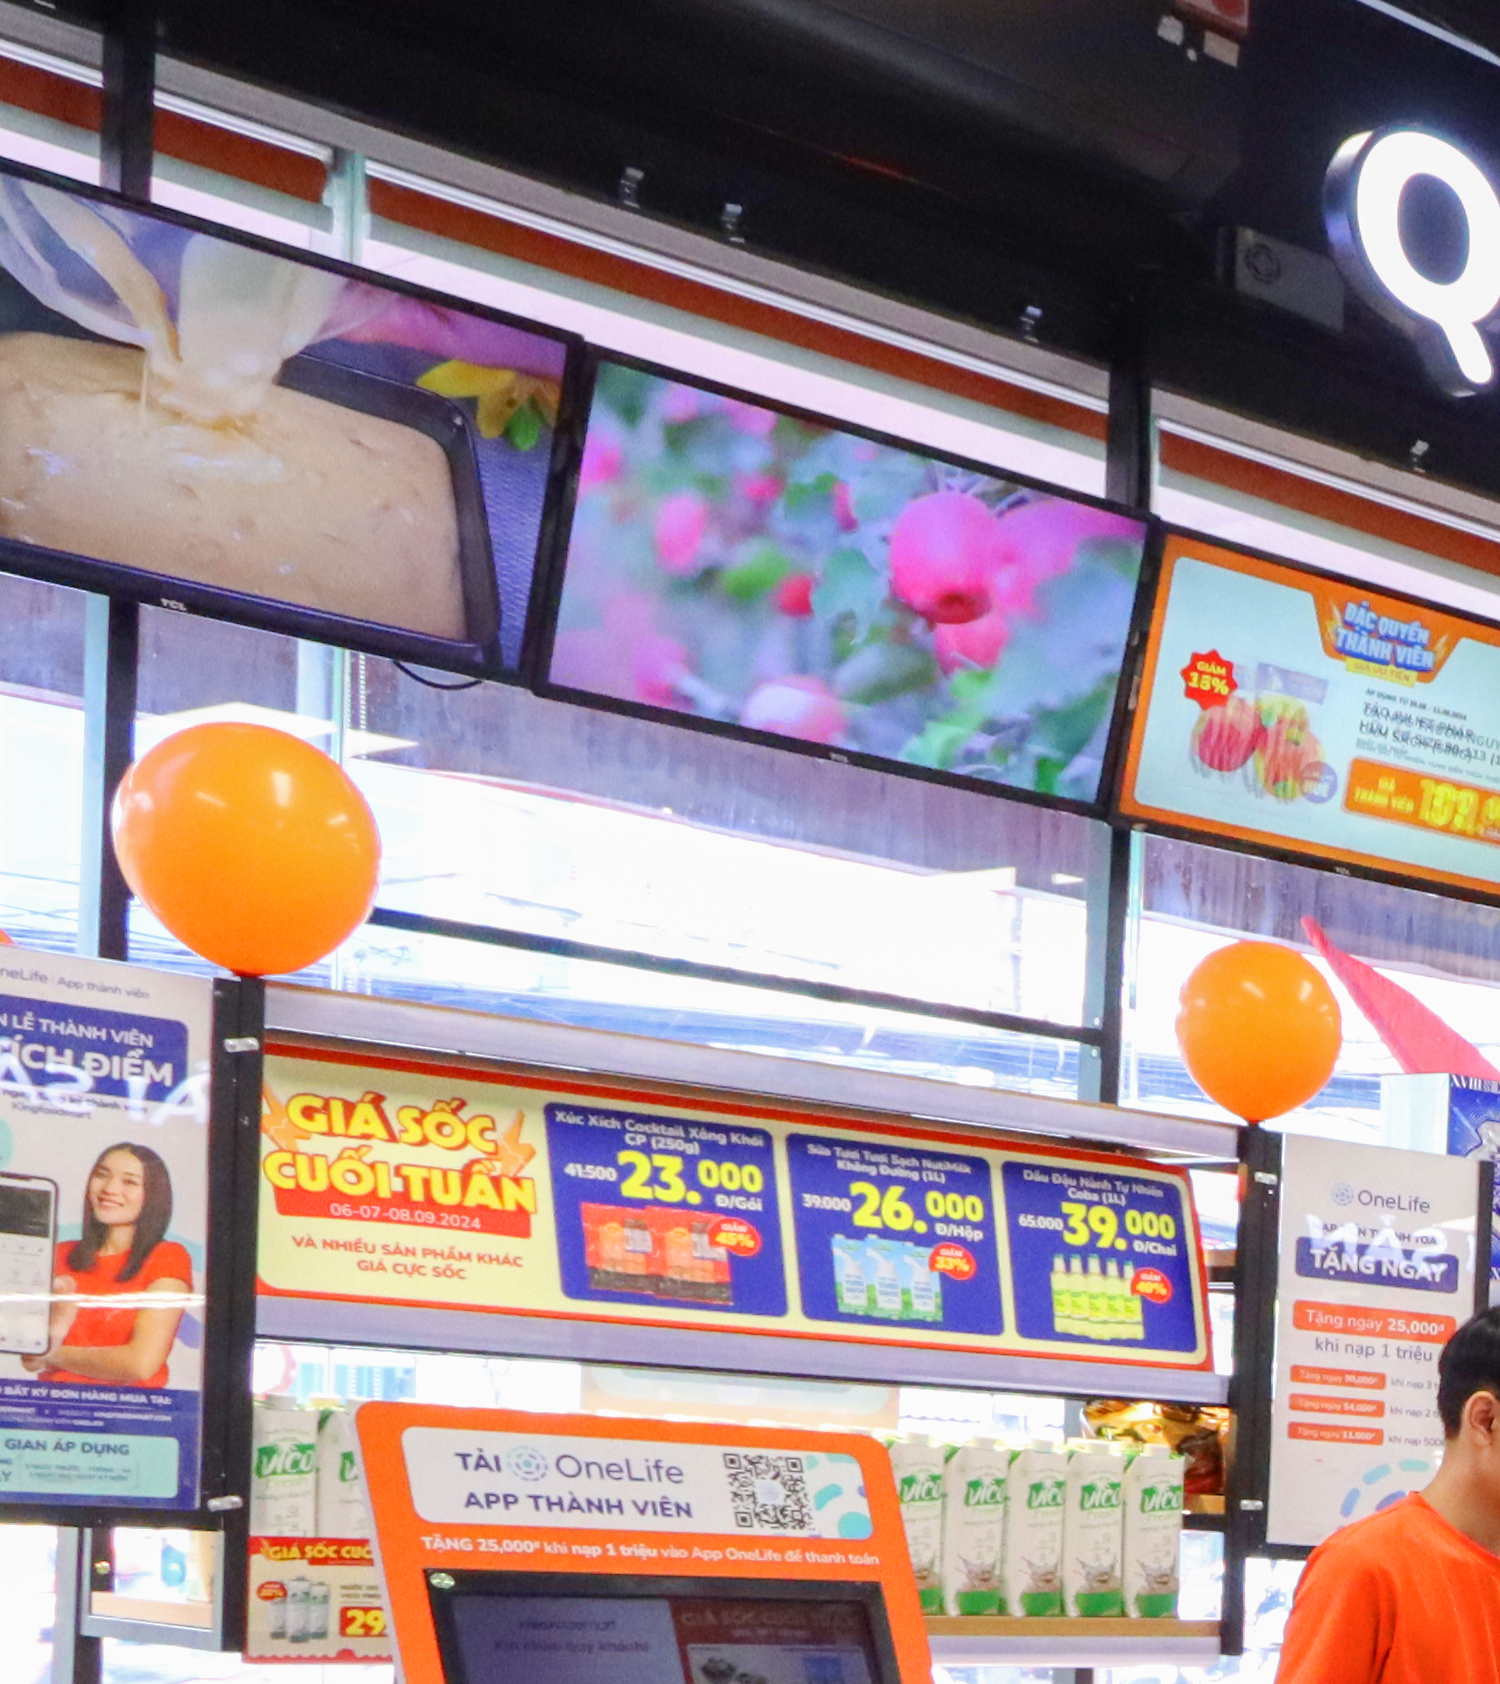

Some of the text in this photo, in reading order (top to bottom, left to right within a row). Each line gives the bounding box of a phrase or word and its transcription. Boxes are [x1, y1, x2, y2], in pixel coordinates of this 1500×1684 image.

[1343, 601, 1430, 644] ĐẶC QUYỀN
[1335, 626, 1435, 671] THÀNH VIÊN
[1188, 672, 1230, 696] 15%
[39, 1019, 154, 1048] THÀNH VIÊN
[286, 1091, 498, 1154] GIÁ SỐC
[263, 1145, 537, 1215] CUỐI TUẦN
[1357, 1189, 1432, 1215] OneLife
[292, 1234, 523, 1267] VÀ NHIỀU SẢN KHÁC
[1309, 1244, 1376, 1276] TẶNG
[357, 1259, 466, 1280] GIÁ CỰC SỐC
[1305, 1308, 1383, 1332] Tặng ngay
[1315, 1338, 1433, 1363] khi nạp triệu
[5, 1438, 130, 1457] GIAN DỤNG
[455, 1449, 686, 1486] TẢI OneLife
[463, 1491, 693, 1519] APP THÀNH VIÊN
[420, 1534, 474, 1555] TẶNG
